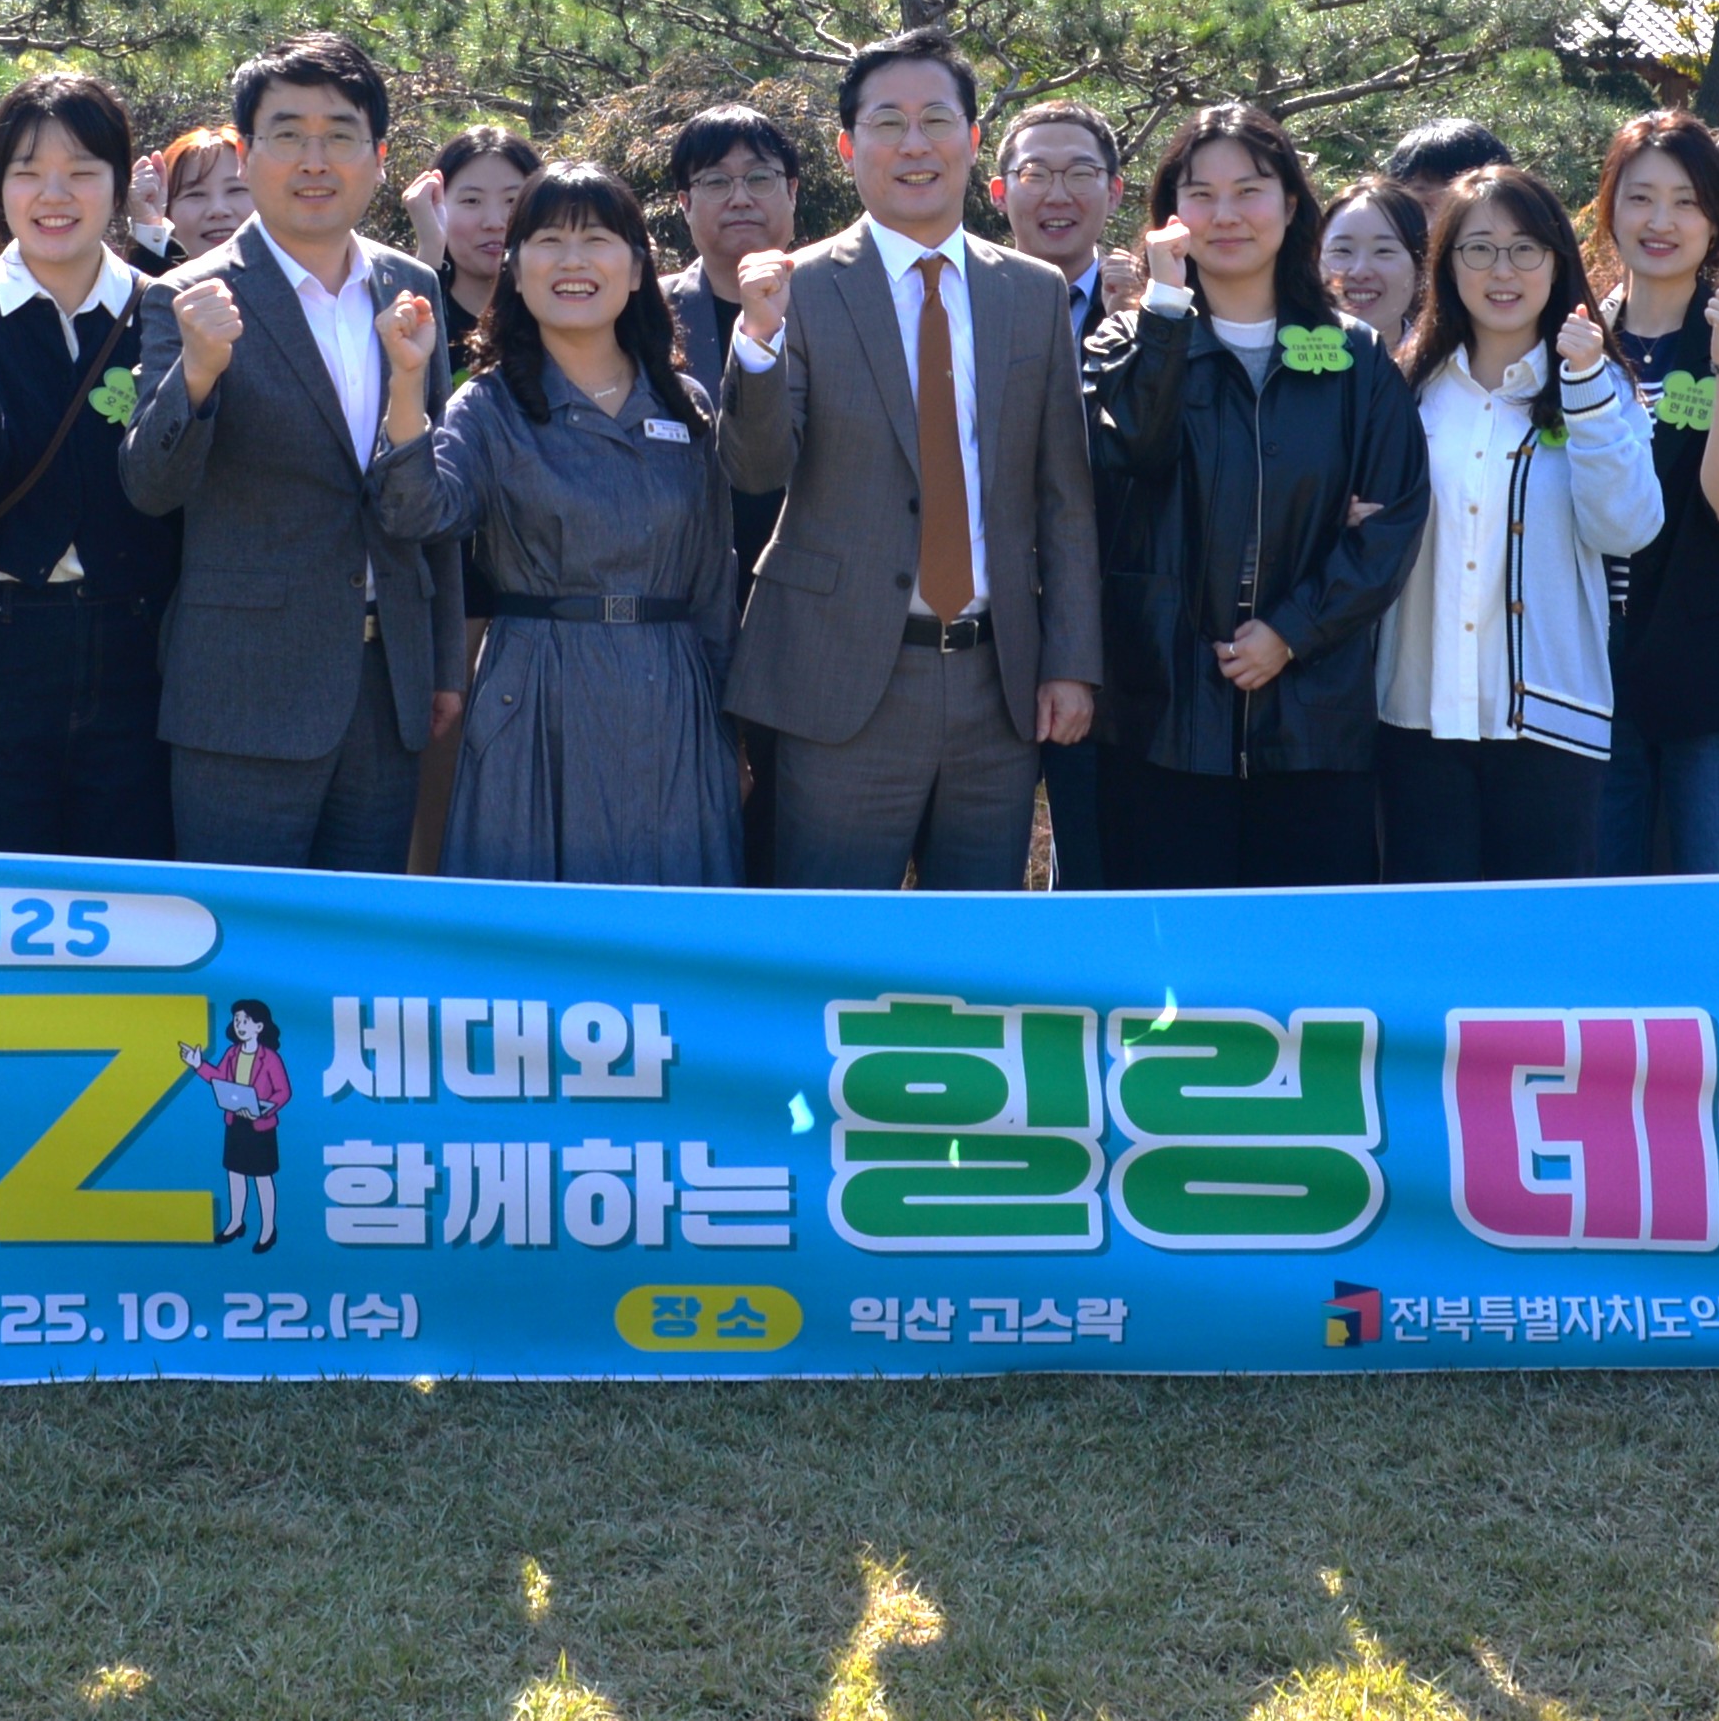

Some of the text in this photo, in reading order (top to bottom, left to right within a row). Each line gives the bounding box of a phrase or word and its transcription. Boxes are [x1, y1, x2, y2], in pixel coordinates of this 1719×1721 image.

[322, 995, 673, 1102] 세대와
[824, 992, 1380, 1253] 힐링
[322, 1139, 792, 1248] 함께하는
[849, 1296, 958, 1343] 익산
[968, 1296, 1129, 1344] 고스락
